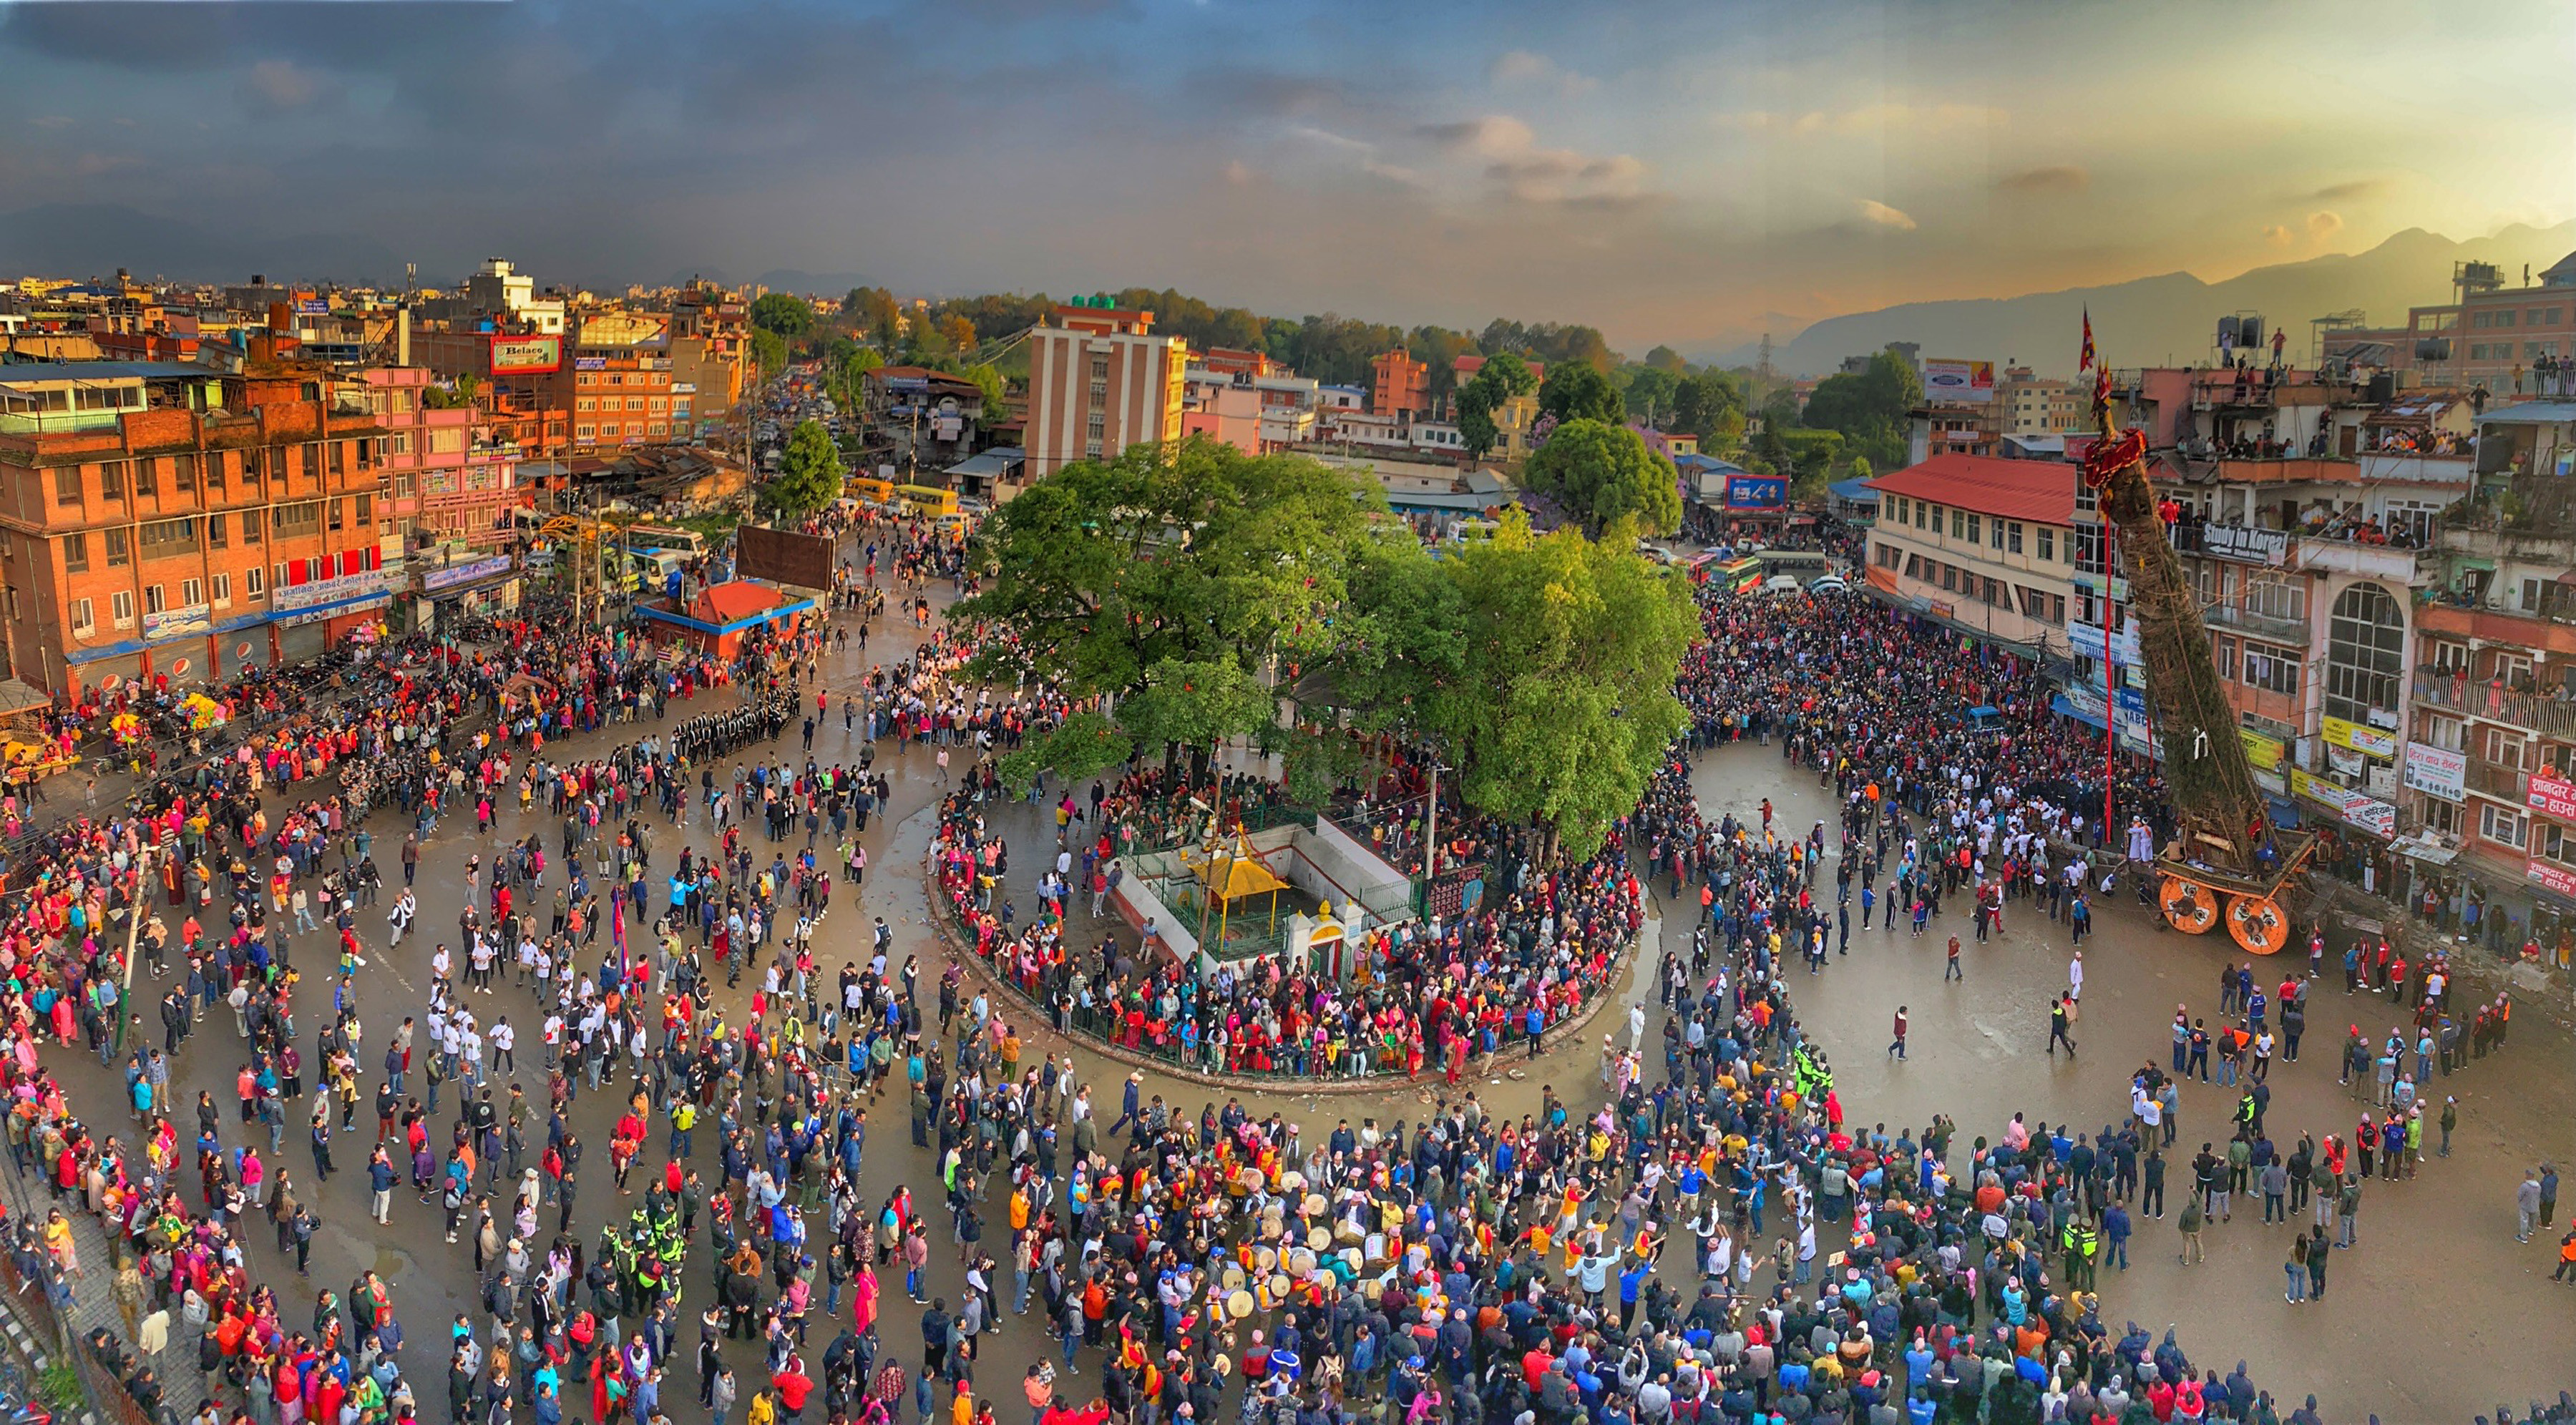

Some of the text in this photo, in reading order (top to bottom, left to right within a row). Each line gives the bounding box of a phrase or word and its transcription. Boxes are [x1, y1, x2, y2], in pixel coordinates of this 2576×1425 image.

[506, 346, 542, 355] Belaco
[2204, 523, 2235, 547] Study
[2235, 527, 2248, 548] in
[2129, 711, 2147, 726] ABC
[2532, 778, 2570, 800] शानदार
[2549, 798, 2575, 817] हाउस
[2530, 863, 2565, 881] शानदार
[2545, 877, 2571, 892] हाउस
